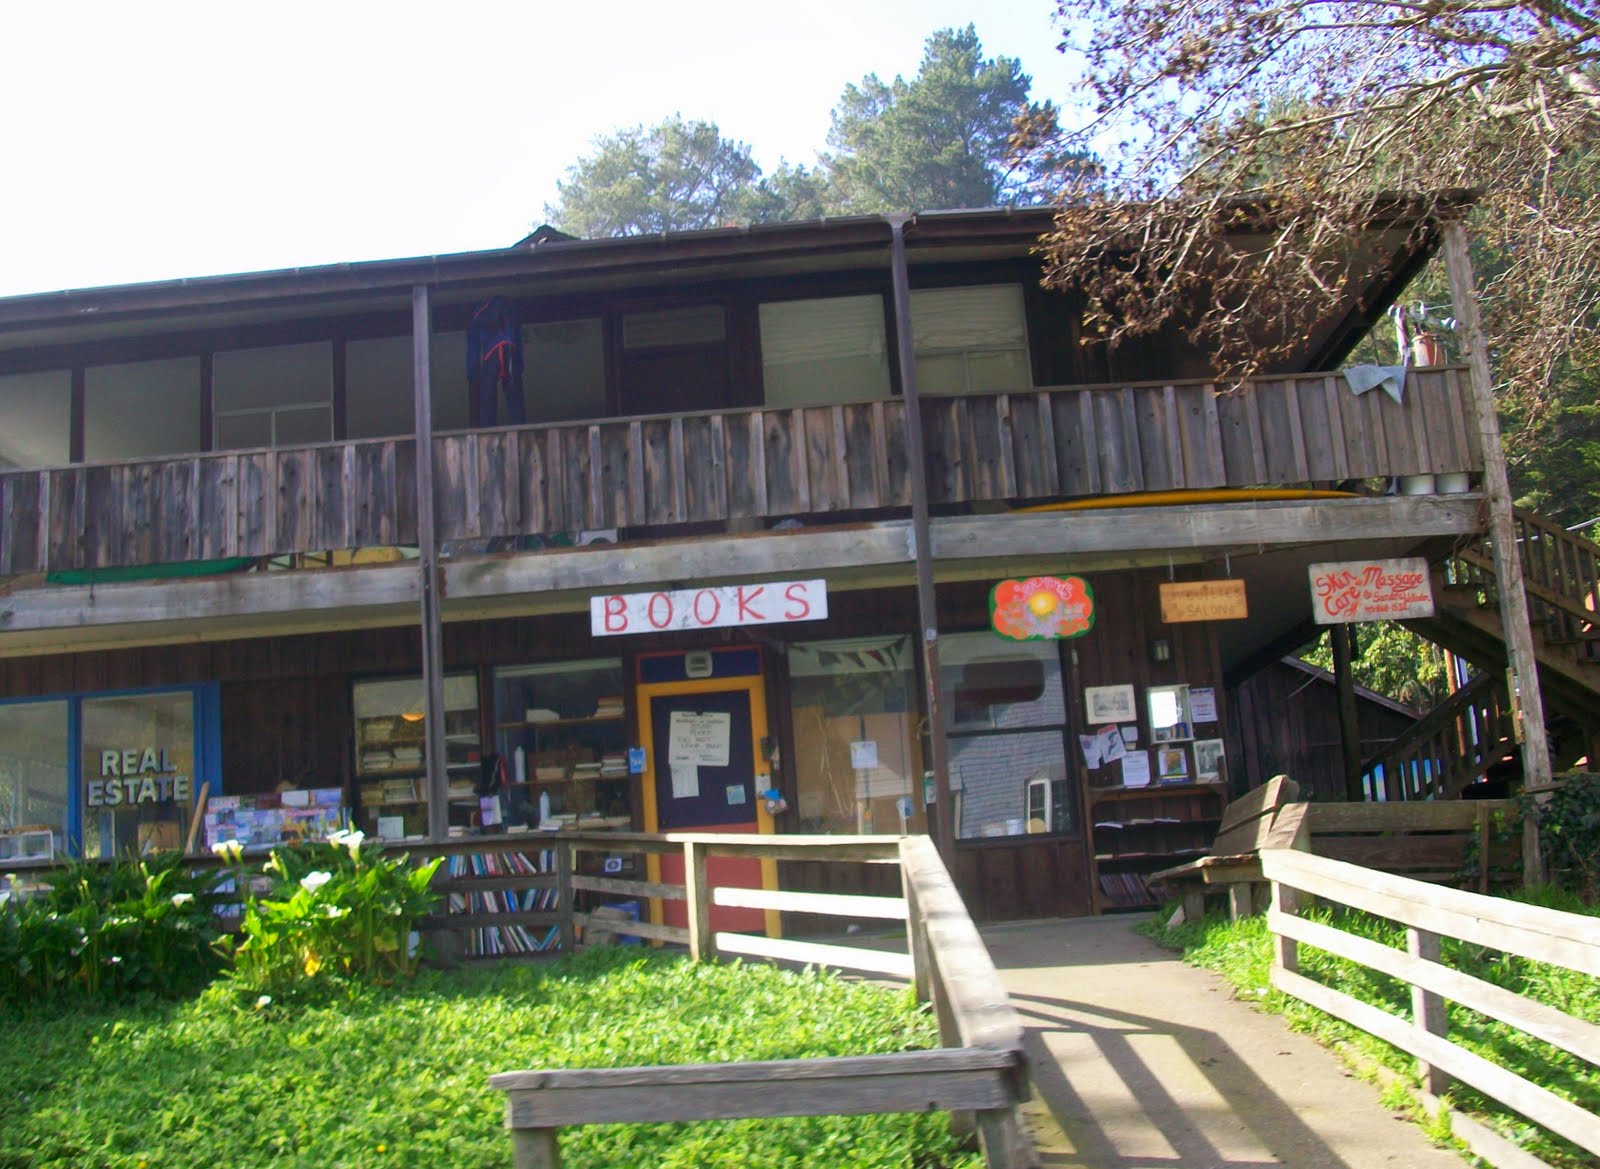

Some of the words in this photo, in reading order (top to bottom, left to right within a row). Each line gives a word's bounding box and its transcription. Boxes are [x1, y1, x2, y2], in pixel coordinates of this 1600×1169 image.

[1363, 566, 1424, 593] Massage
[604, 583, 811, 632] BOOKS
[1324, 586, 1361, 616] Care
[101, 749, 177, 777] REAL
[87, 775, 190, 807] ESTATE
